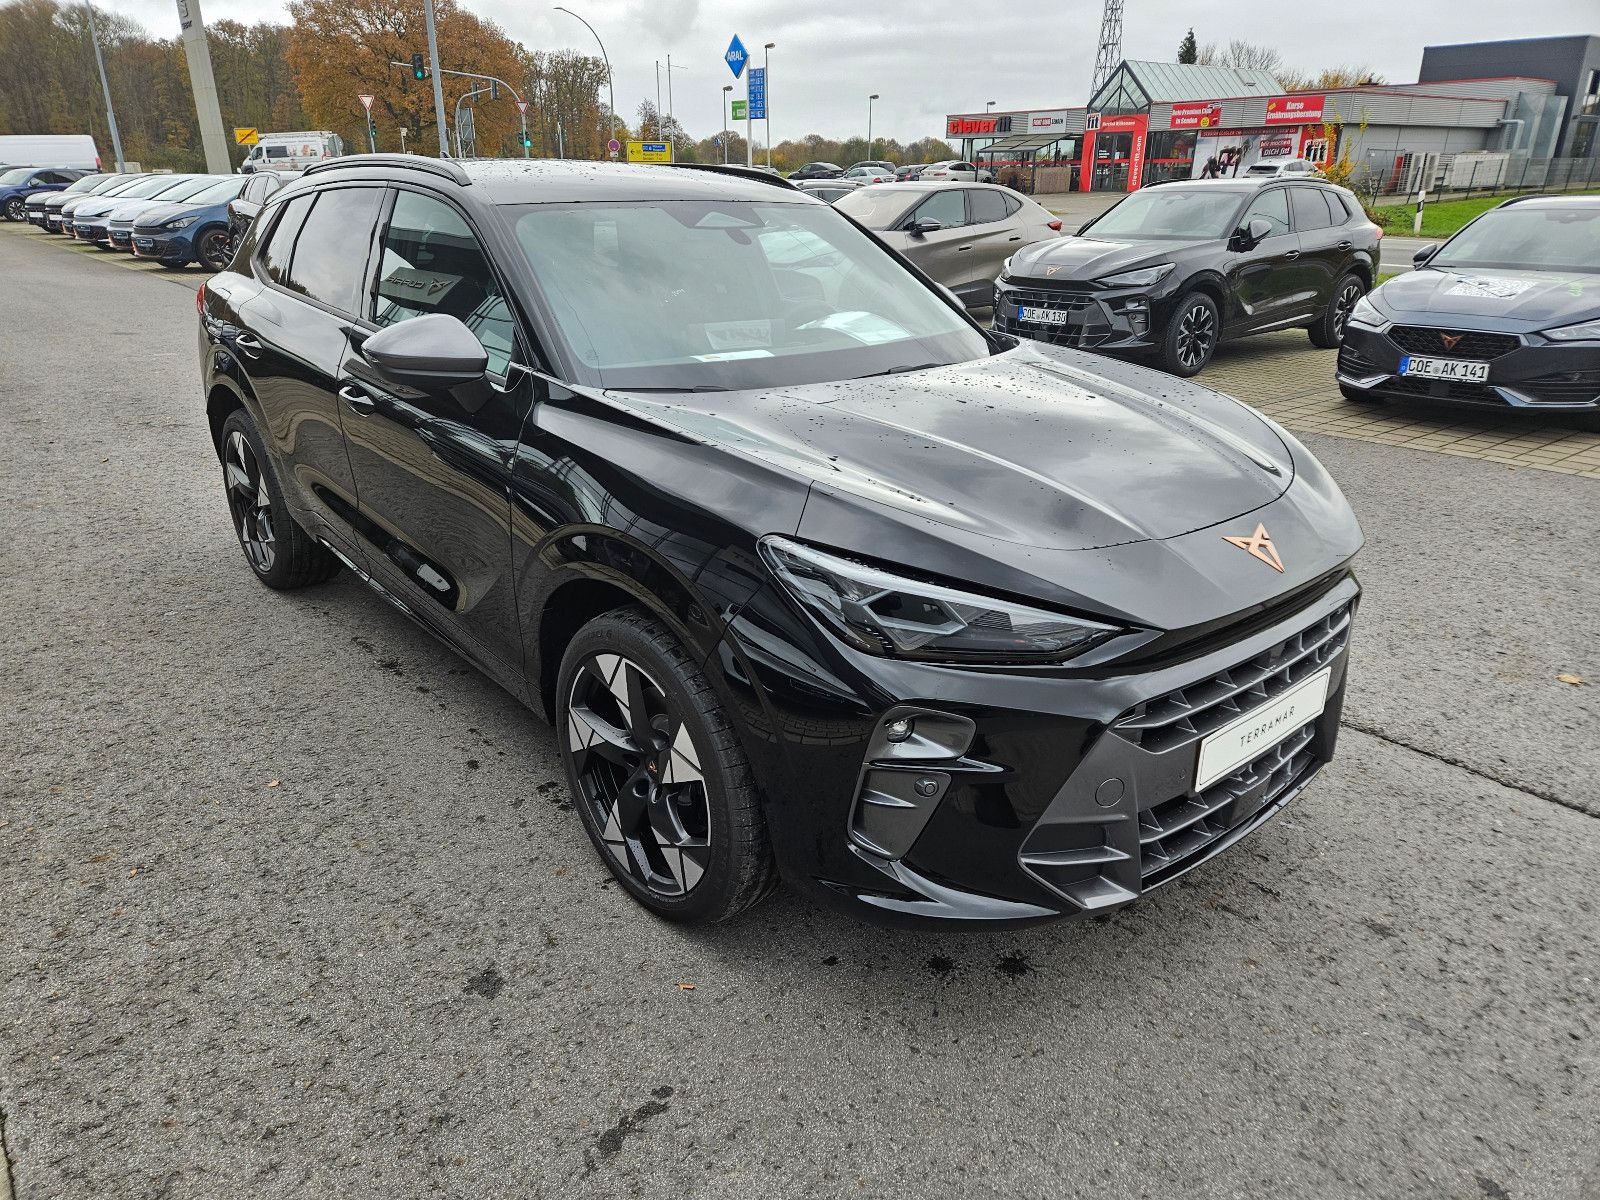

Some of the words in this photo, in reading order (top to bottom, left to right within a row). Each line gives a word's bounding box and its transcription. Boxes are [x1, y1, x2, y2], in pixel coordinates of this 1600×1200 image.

[727, 50, 744, 61] ARAL
[949, 117, 997, 134] clever
[1087, 116, 1099, 129] fit
[1132, 136, 1142, 186] clever-fit.com
[1024, 308, 1036, 319] COE
[1041, 310, 1051, 320] AK
[1408, 359, 1432, 374] COE
[1441, 362, 1459, 376] AK
[1461, 364, 1486, 378] 141
[1240, 705, 1295, 747] TERRAMAR
